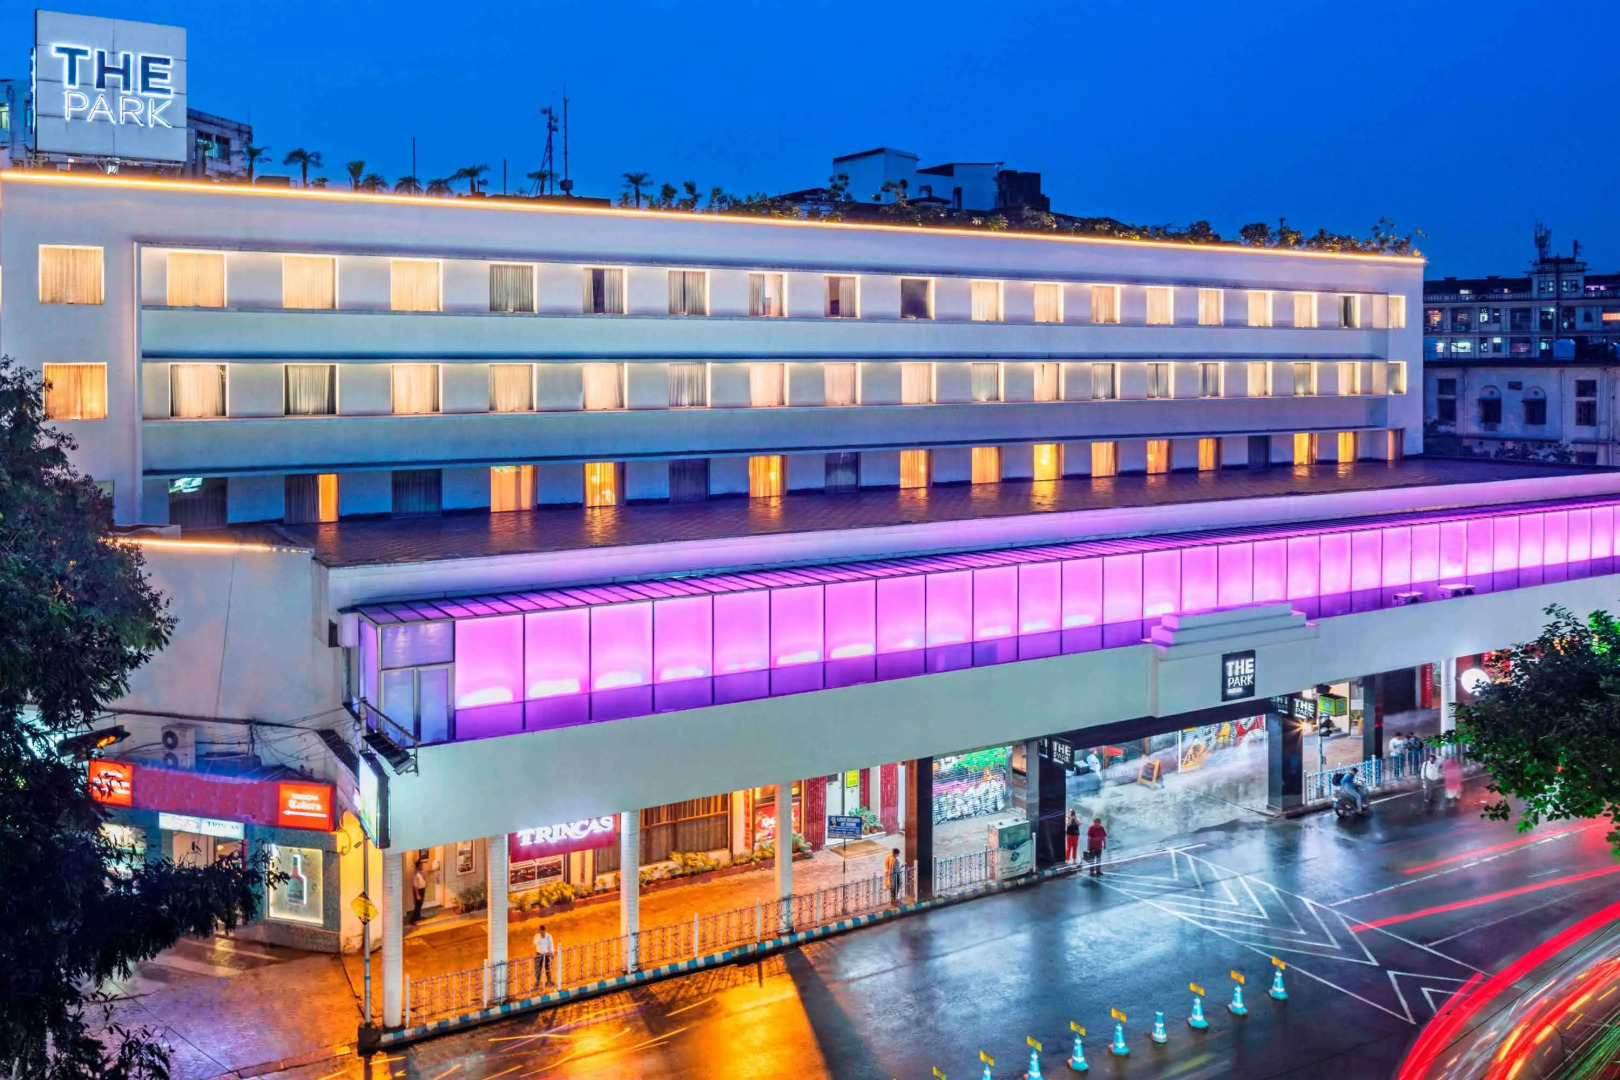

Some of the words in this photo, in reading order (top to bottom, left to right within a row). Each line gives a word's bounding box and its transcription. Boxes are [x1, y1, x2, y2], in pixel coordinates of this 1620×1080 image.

[52, 43, 174, 97] THE
[65, 91, 173, 128] PARK
[1226, 658, 1254, 676] THE
[1228, 674, 1253, 688] PARK
[1293, 698, 1315, 712] THE
[1295, 707, 1315, 719] PARK
[1052, 741, 1071, 756] THE
[1053, 752, 1071, 763] PARK
[516, 815, 615, 847] TRINCAS
